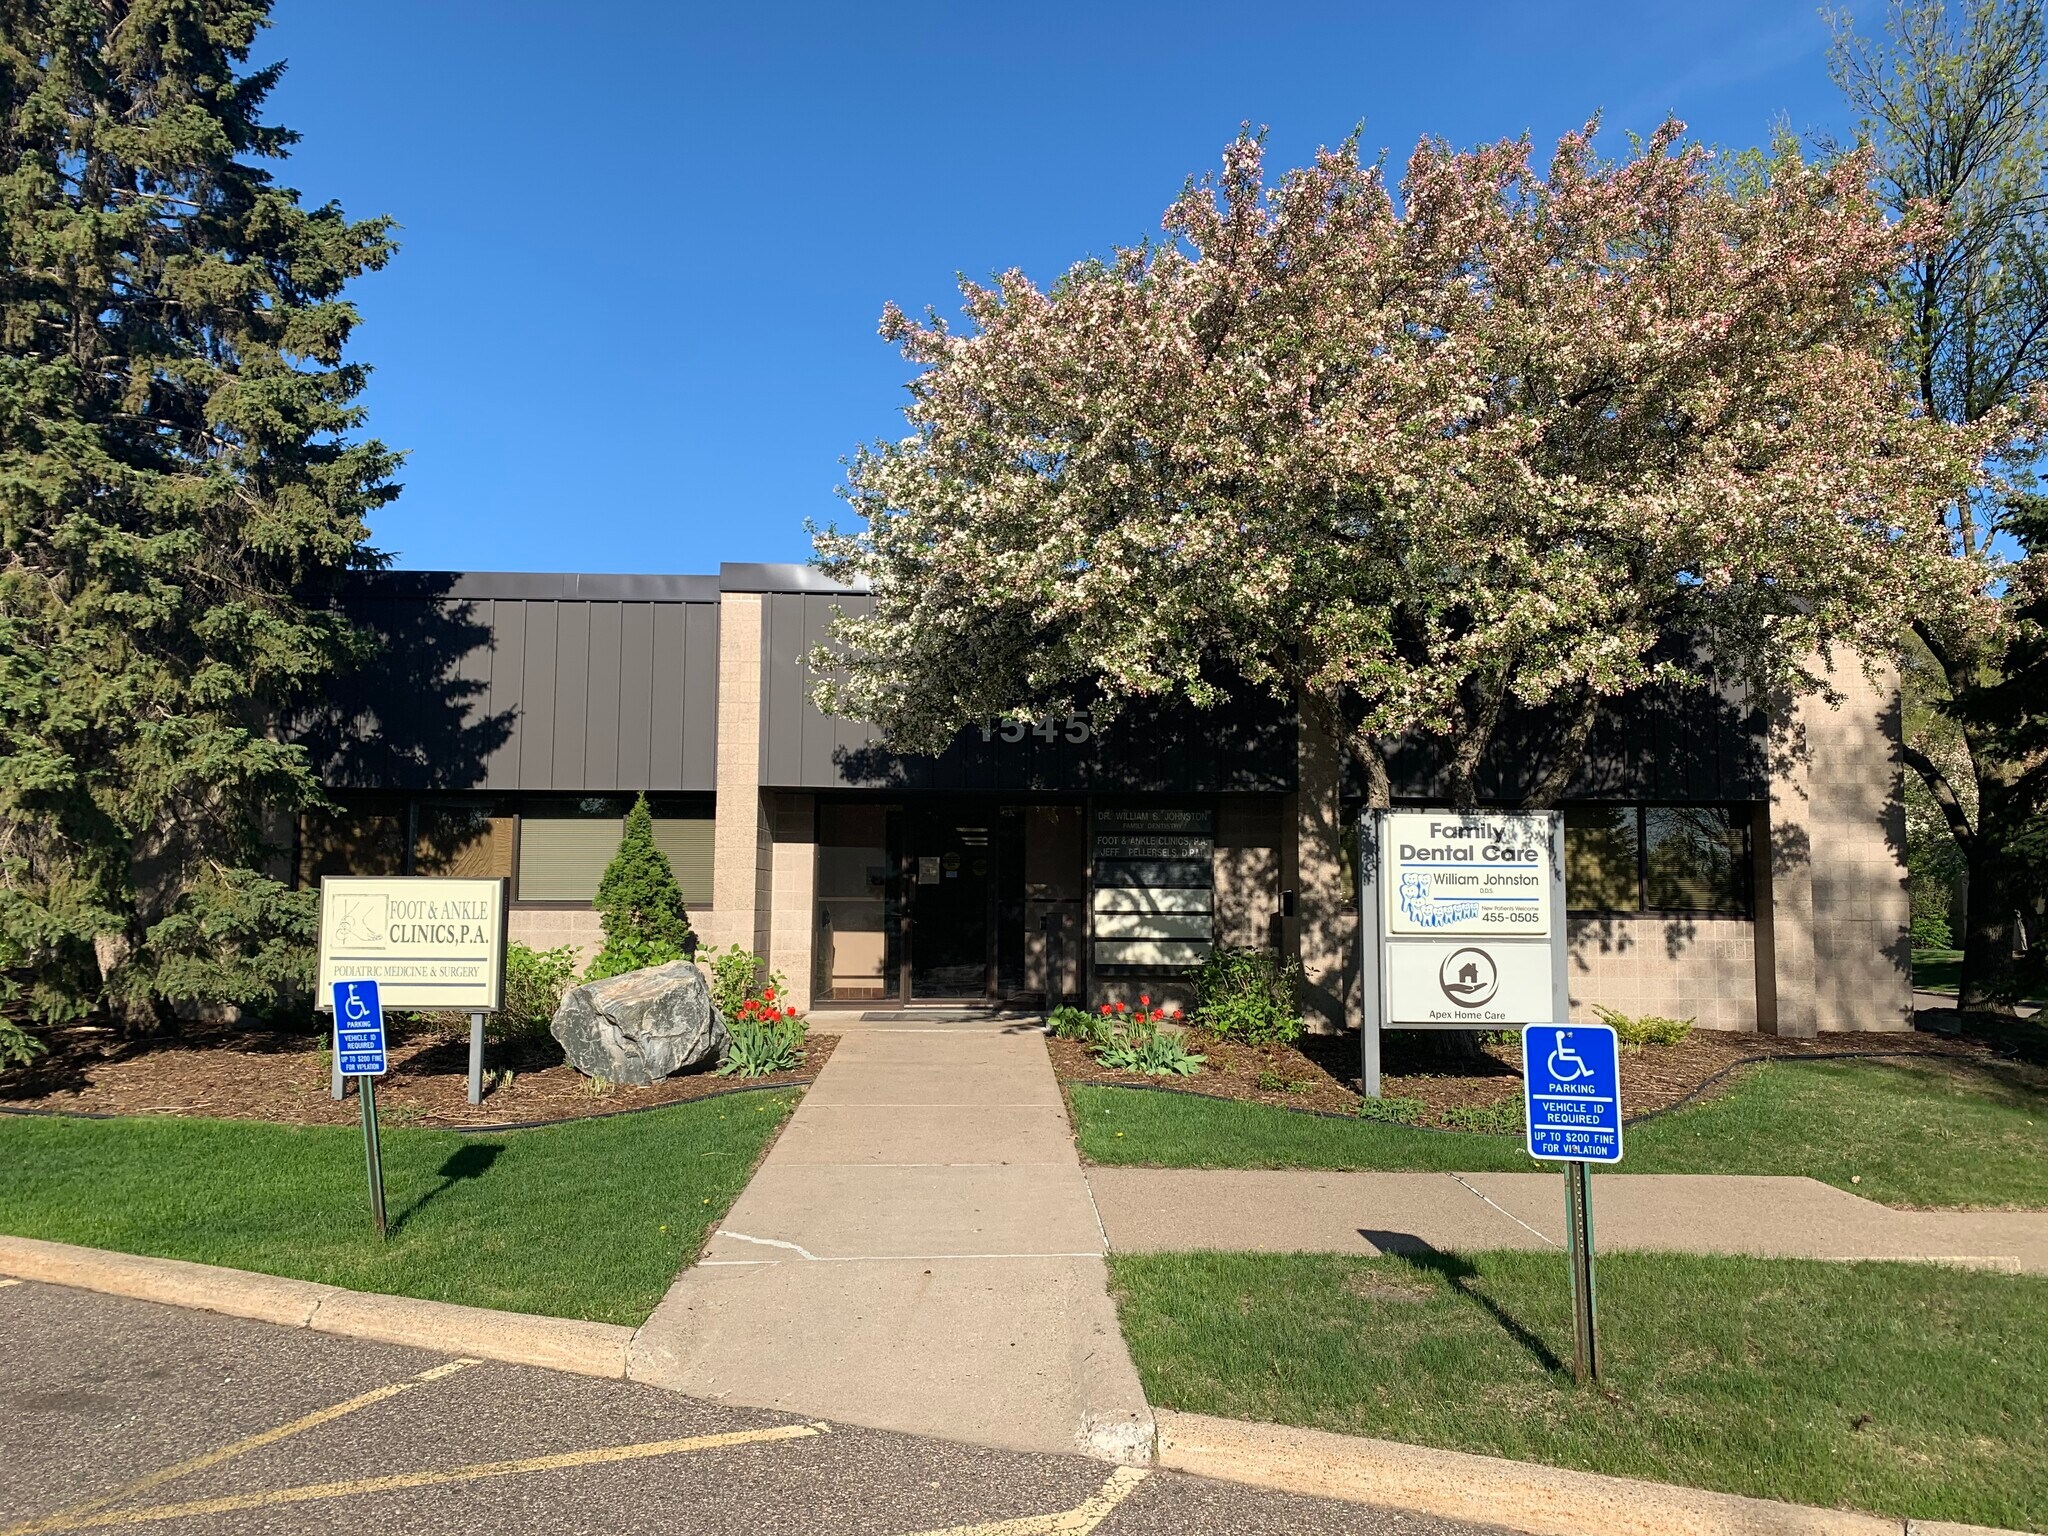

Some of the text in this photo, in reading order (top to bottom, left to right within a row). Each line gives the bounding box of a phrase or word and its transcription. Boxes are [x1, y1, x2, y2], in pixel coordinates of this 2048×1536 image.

[980, 710, 1090, 744] 1545
[1116, 812, 1148, 820] WILLIAM
[1164, 812, 1208, 822] JOHNSTON
[1430, 822, 1505, 843] Family
[1097, 836, 1118, 846] FOOT
[1121, 836, 1126, 845] &
[1130, 836, 1156, 846] ANKLE
[1158, 837, 1190, 847] CLINICS,
[1100, 848, 1120, 856] JEFF
[1400, 844, 1539, 862] Dental Care
[1434, 873, 1539, 886] William Johnston
[390, 900, 488, 920] FOOT & ANKLE
[1482, 912, 1539, 922] 455-0505
[334, 966, 480, 978] PODIATRIC MEDICINE & SURGERY
[1429, 1010, 1506, 1022] Apex Home Care
[1548, 1083, 1596, 1094] PARKING
[1542, 1102, 1604, 1114] VEHICLE ID
[1547, 1114, 1600, 1124] REQUIRED
[1534, 1132, 1615, 1144] UP TO $200 FINE
[1542, 1143, 1560, 1153] FOR
